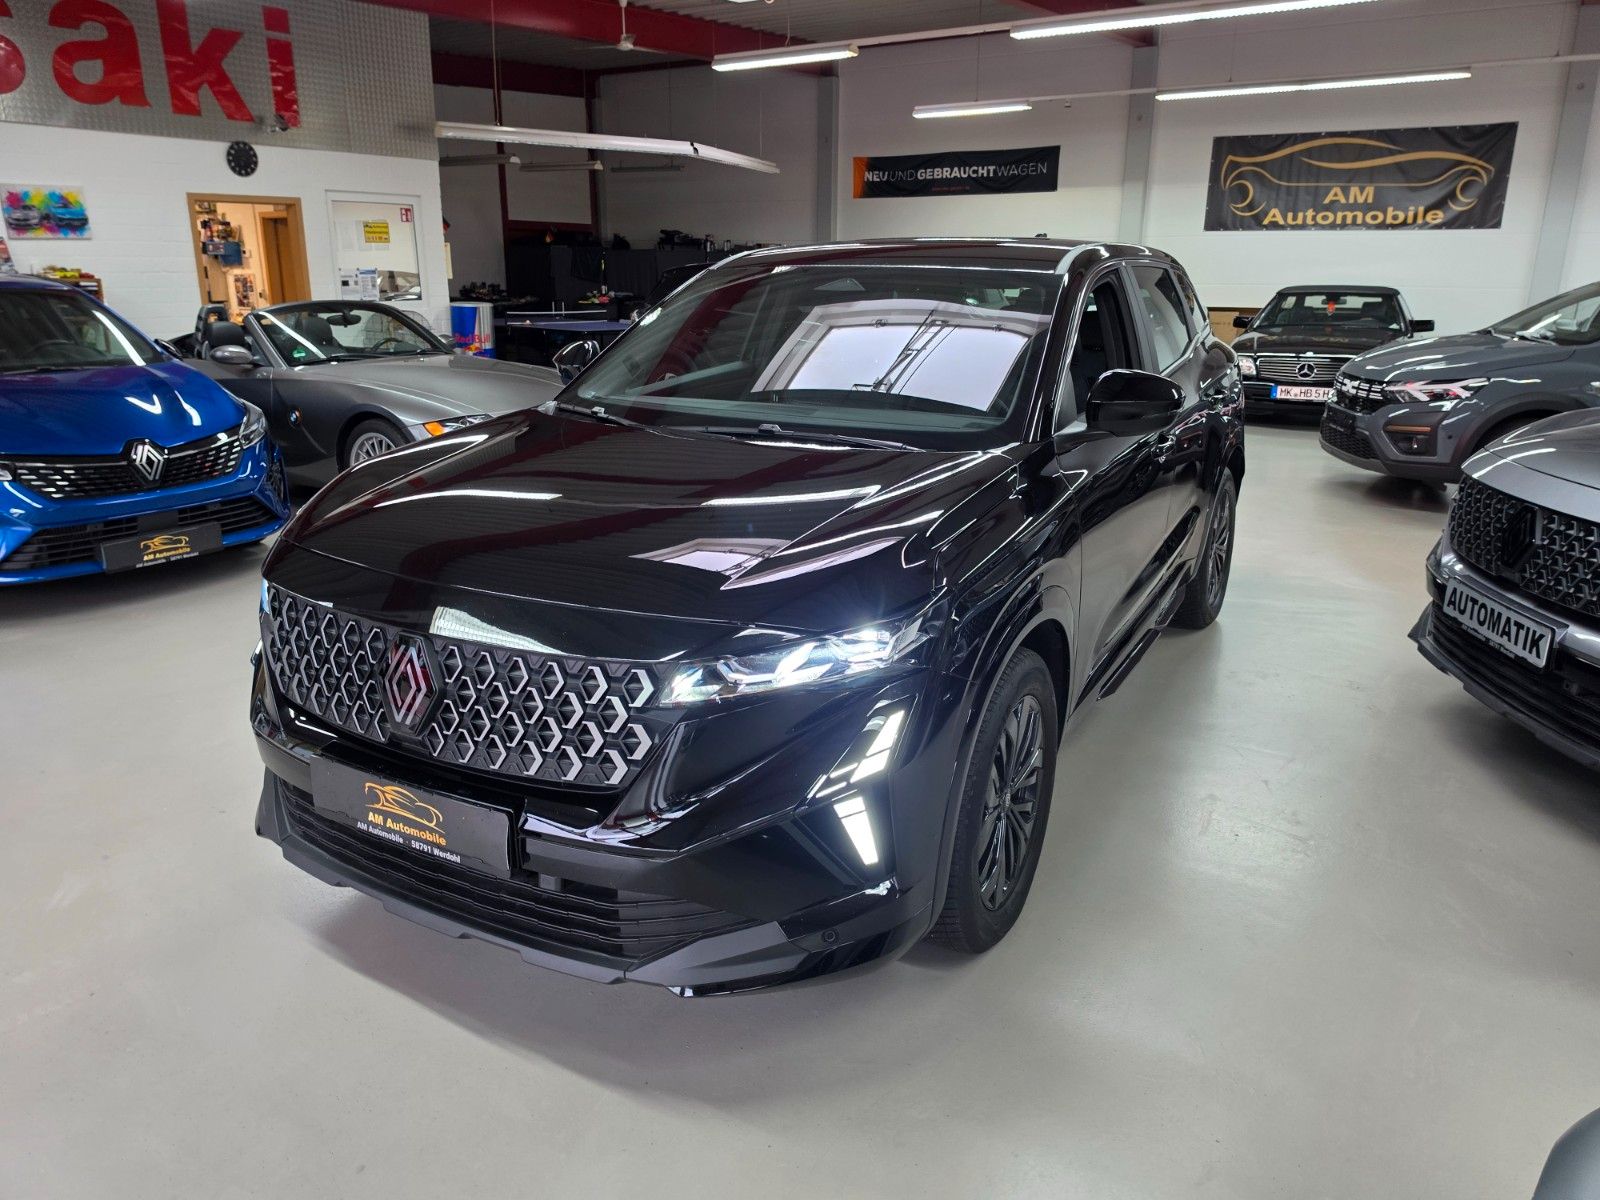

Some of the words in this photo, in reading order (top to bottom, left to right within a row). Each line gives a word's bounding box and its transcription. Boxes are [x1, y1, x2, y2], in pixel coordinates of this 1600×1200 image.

[0, 0, 299, 128] aki
[1323, 186, 1375, 204] AM
[1262, 206, 1445, 225] Automobile
[1280, 388, 1292, 397] MK
[1447, 586, 1546, 660] AUTOMATIK
[357, 822, 368, 831] AM
[369, 826, 404, 844] Automobile
[411, 840, 431, 853] 58791
[432, 847, 461, 864] Werdohl
[368, 811, 384, 826] AM
[386, 818, 447, 846] Automobile
